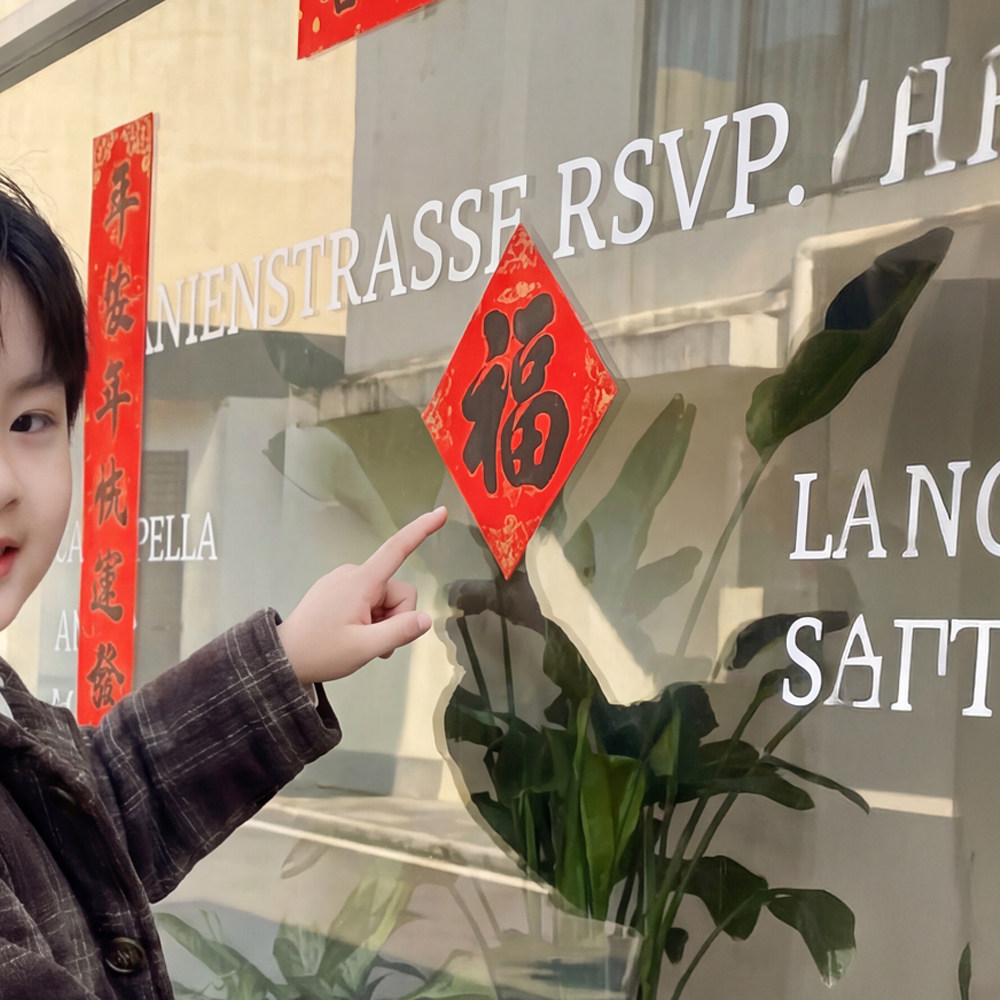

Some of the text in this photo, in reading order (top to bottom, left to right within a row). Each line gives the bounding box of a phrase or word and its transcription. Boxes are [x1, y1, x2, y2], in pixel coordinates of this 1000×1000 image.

[145, 174, 528, 356] NIENSTRASSE
[553, 102, 805, 260] RSVP.
[462, 292, 570, 495] 福
